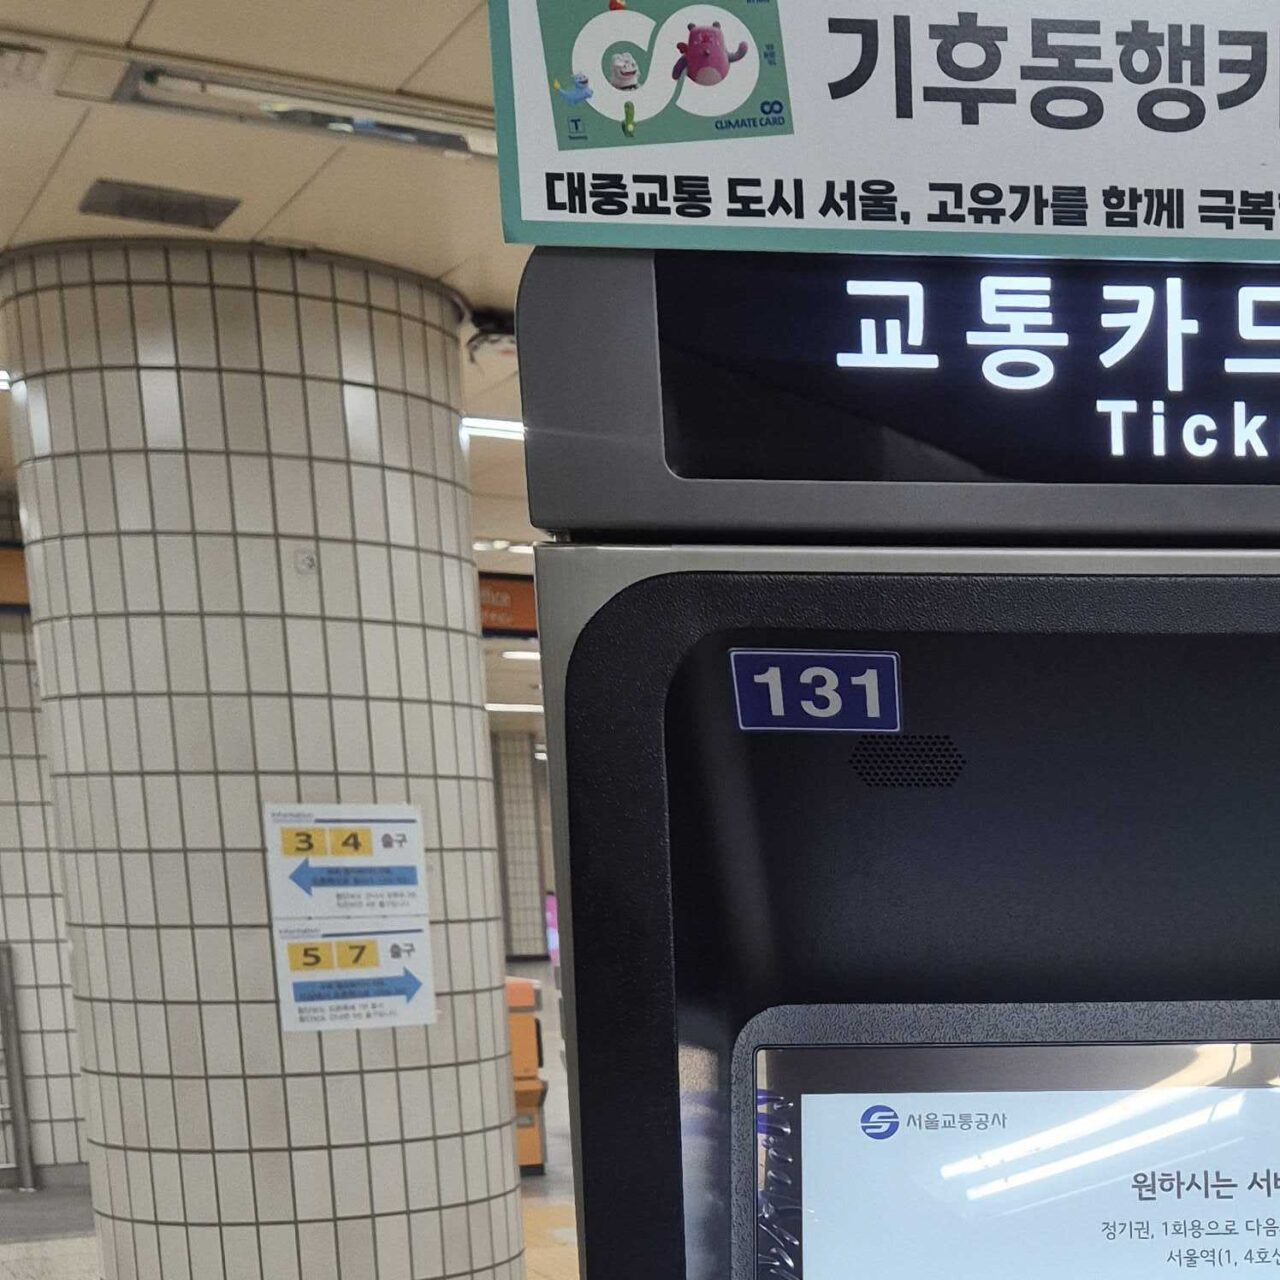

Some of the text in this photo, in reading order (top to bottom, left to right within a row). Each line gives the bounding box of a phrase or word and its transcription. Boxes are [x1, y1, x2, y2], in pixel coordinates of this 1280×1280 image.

[715, 117, 785, 131] CLIMATE CARD
[545, 172, 712, 218] 대중교통
[727, 177, 804, 219] 도시
[818, 179, 910, 225] 서울,
[927, 182, 1089, 226] 고유가를
[1102, 185, 1185, 229] 함께
[754, 666, 880, 718] 131
[294, 832, 314, 852] 3
[341, 832, 362, 851] 4
[303, 947, 321, 966] 5
[349, 945, 367, 964] 7
[906, 1111, 1008, 1132] 서울교통공사
[1132, 1169, 1238, 1201] 원하시는
[1101, 1220, 1155, 1240] 정기권,
[1162, 1219, 1239, 1240] 1회용으로
[1167, 1248, 1238, 1268] 서울역(1,
